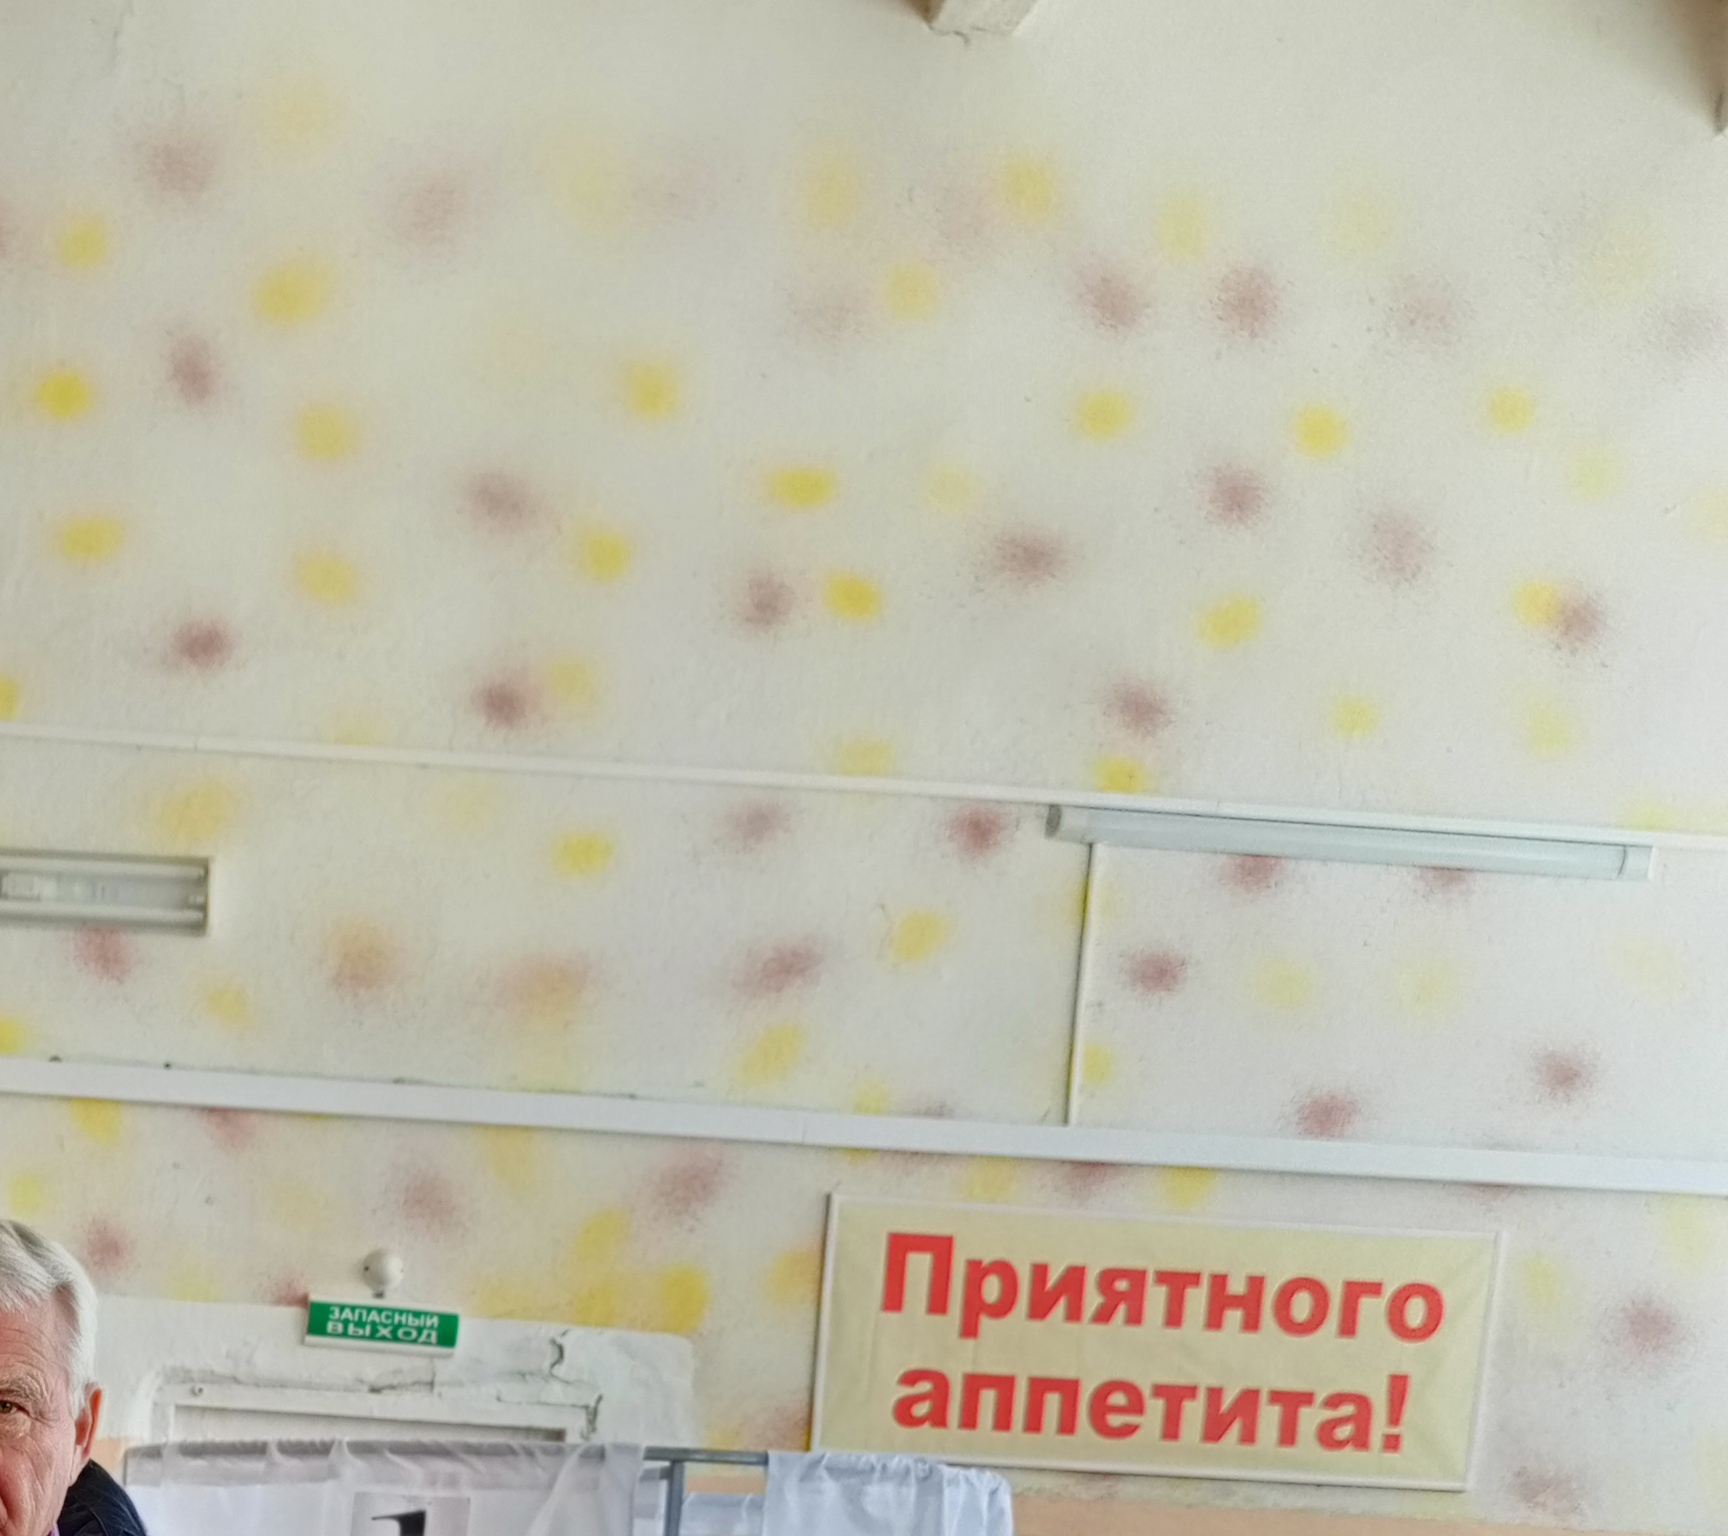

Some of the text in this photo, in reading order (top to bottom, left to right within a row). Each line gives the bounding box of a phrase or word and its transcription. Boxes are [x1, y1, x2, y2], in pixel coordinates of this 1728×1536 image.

[880, 1231, 1445, 1344] Приятного
[326, 1320, 439, 1346] ВЫХОД
[328, 1305, 440, 1330] ЗАПАСНЫЙ
[891, 1367, 1411, 1454] аппетита!
